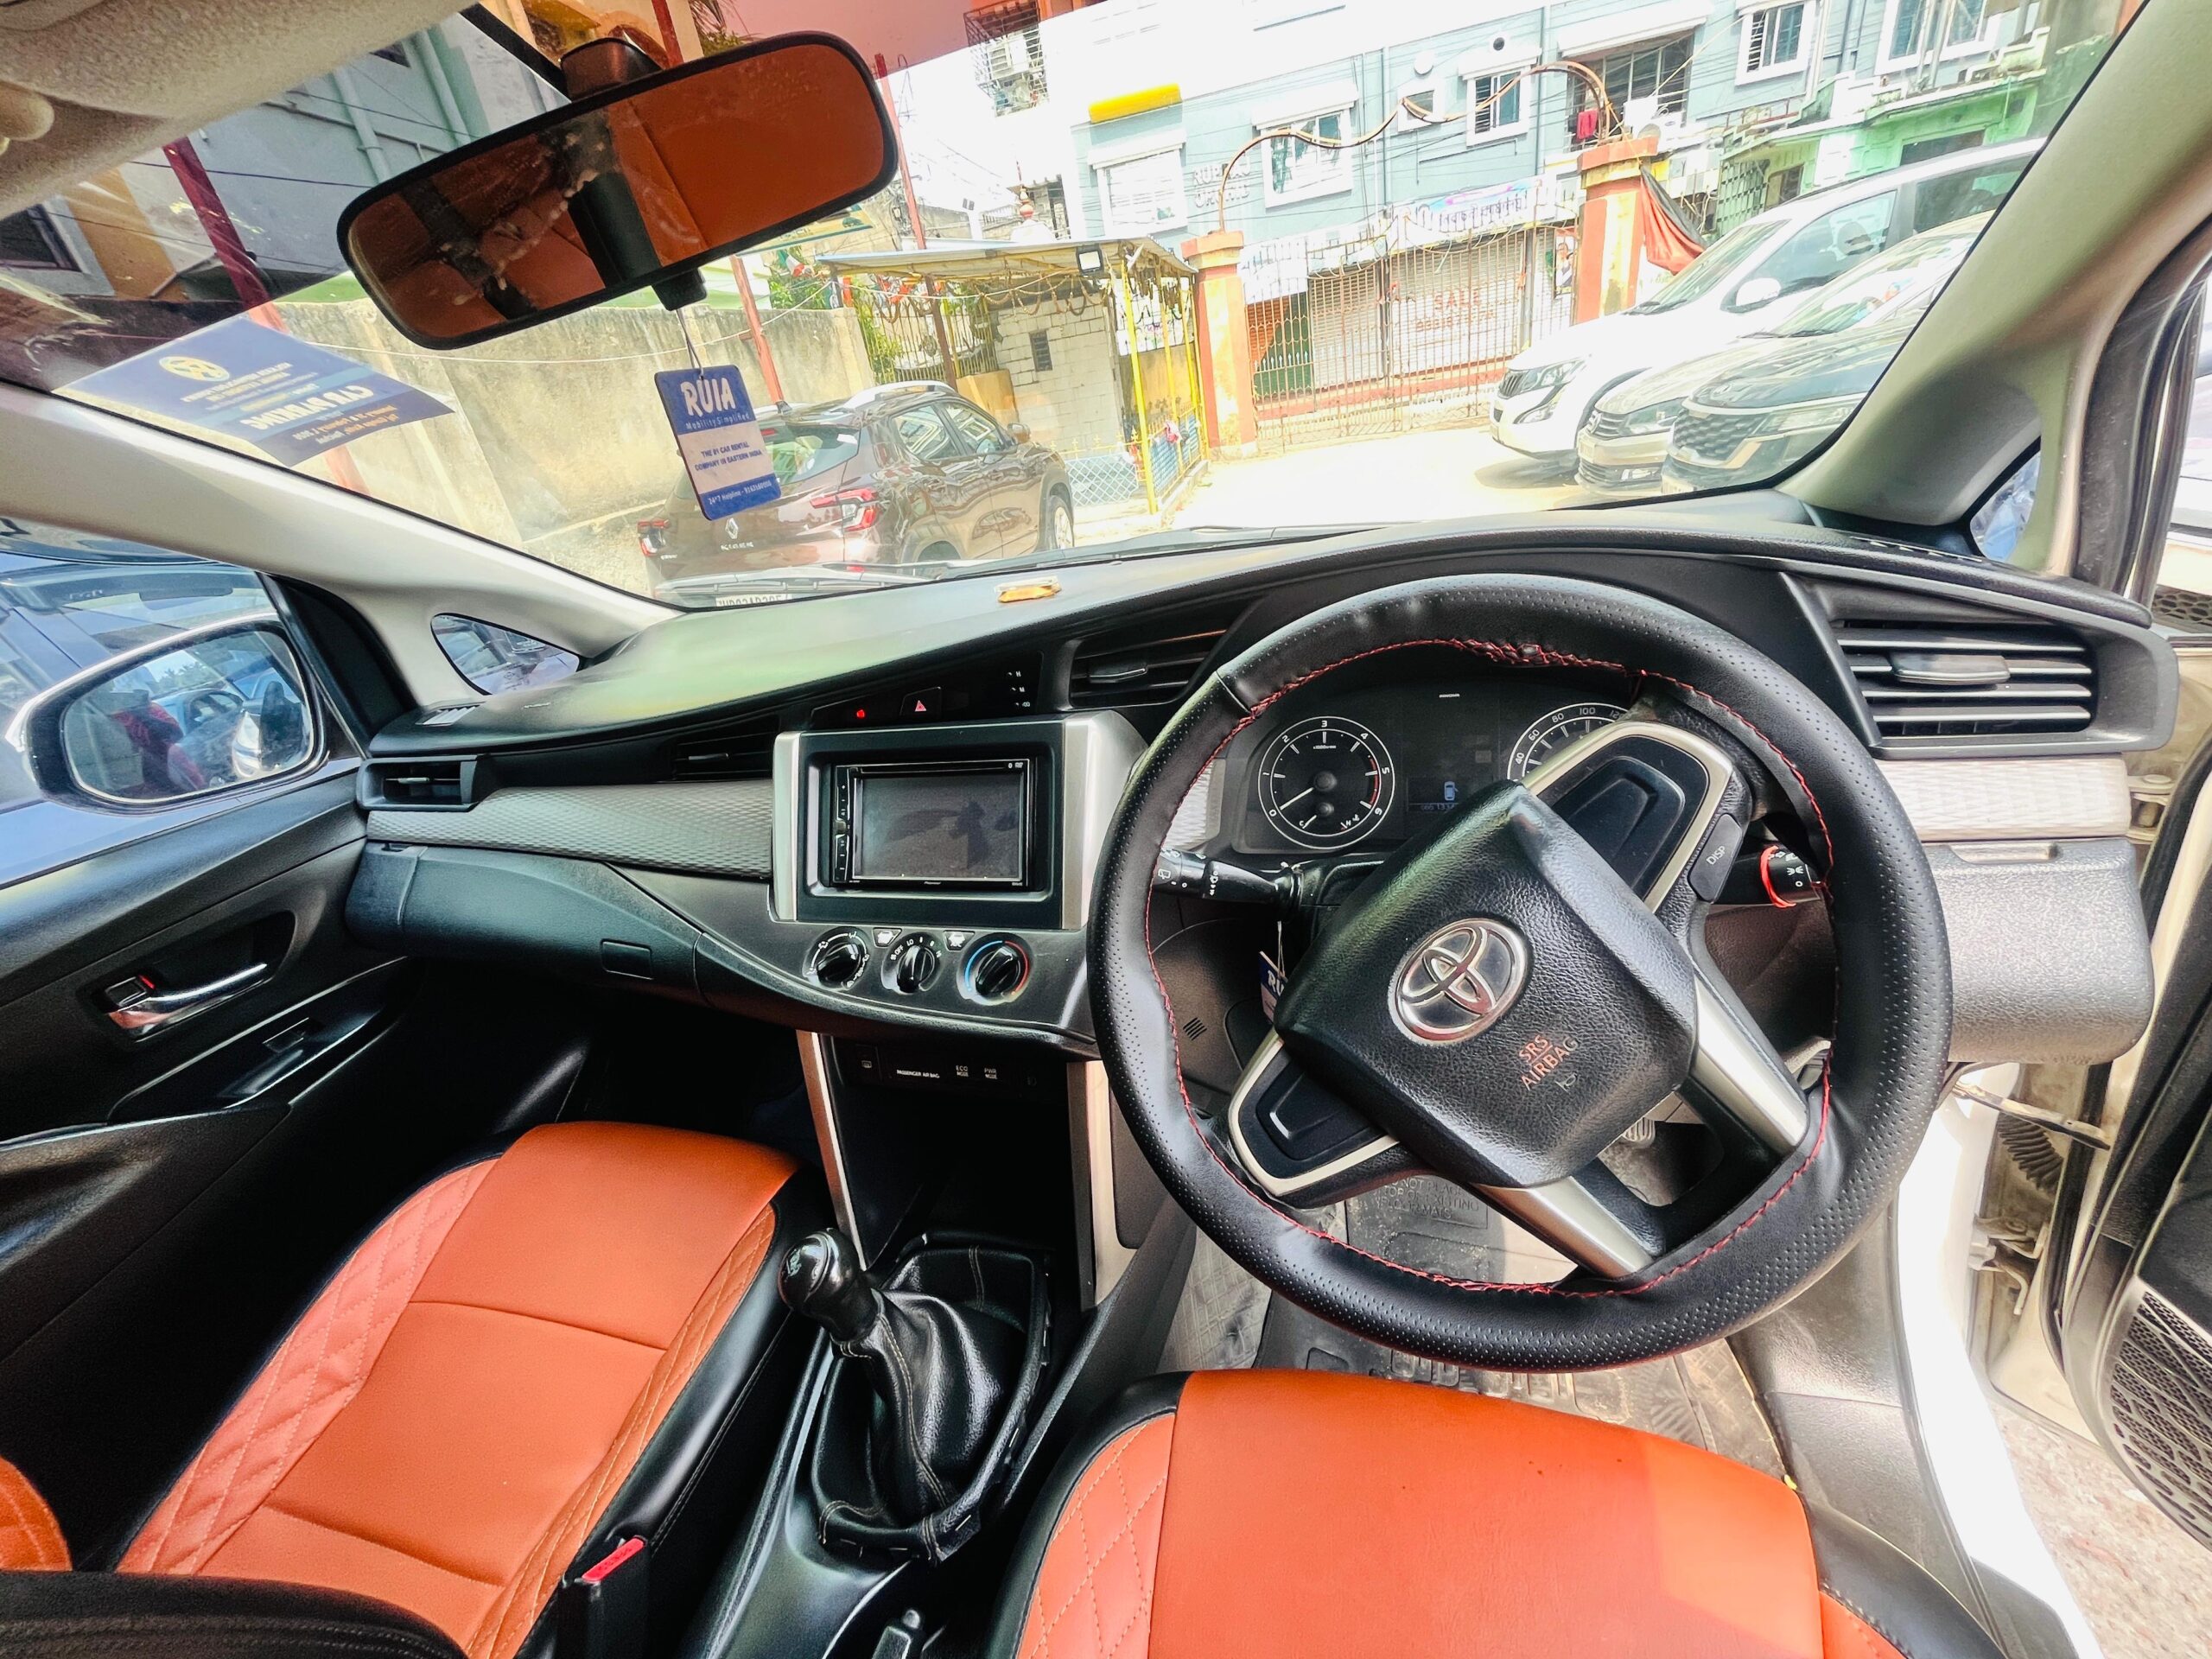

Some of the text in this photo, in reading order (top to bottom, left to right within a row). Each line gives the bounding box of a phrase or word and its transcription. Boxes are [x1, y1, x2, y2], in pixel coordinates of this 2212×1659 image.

[680, 378, 736, 417] RUIA
[701, 449, 713, 458] THE
[720, 445, 731, 454] CAR
[730, 442, 750, 451] RENTAL
[695, 460, 720, 471] COMPANY
[727, 453, 749, 463] EASTERN
[749, 449, 762, 458] INDIA
[1579, 707, 1596, 715] 100
[1551, 713, 1565, 723] 80
[1282, 734, 1290, 743] 2
[1360, 732, 1369, 741] 4
[1528, 728, 1540, 741] 60
[1515, 752, 1525, 765] 40
[1268, 809, 1277, 817] 0
[1374, 807, 1382, 816] 6
[1706, 845, 1726, 865] DISP
[894, 944, 904, 955] OFF
[1268, 969, 1285, 996] RU
[1519, 1034, 1548, 1062] SRS
[1521, 1036, 1579, 1091] AIRBAG
[1403, 1179, 1424, 1189] NOT
